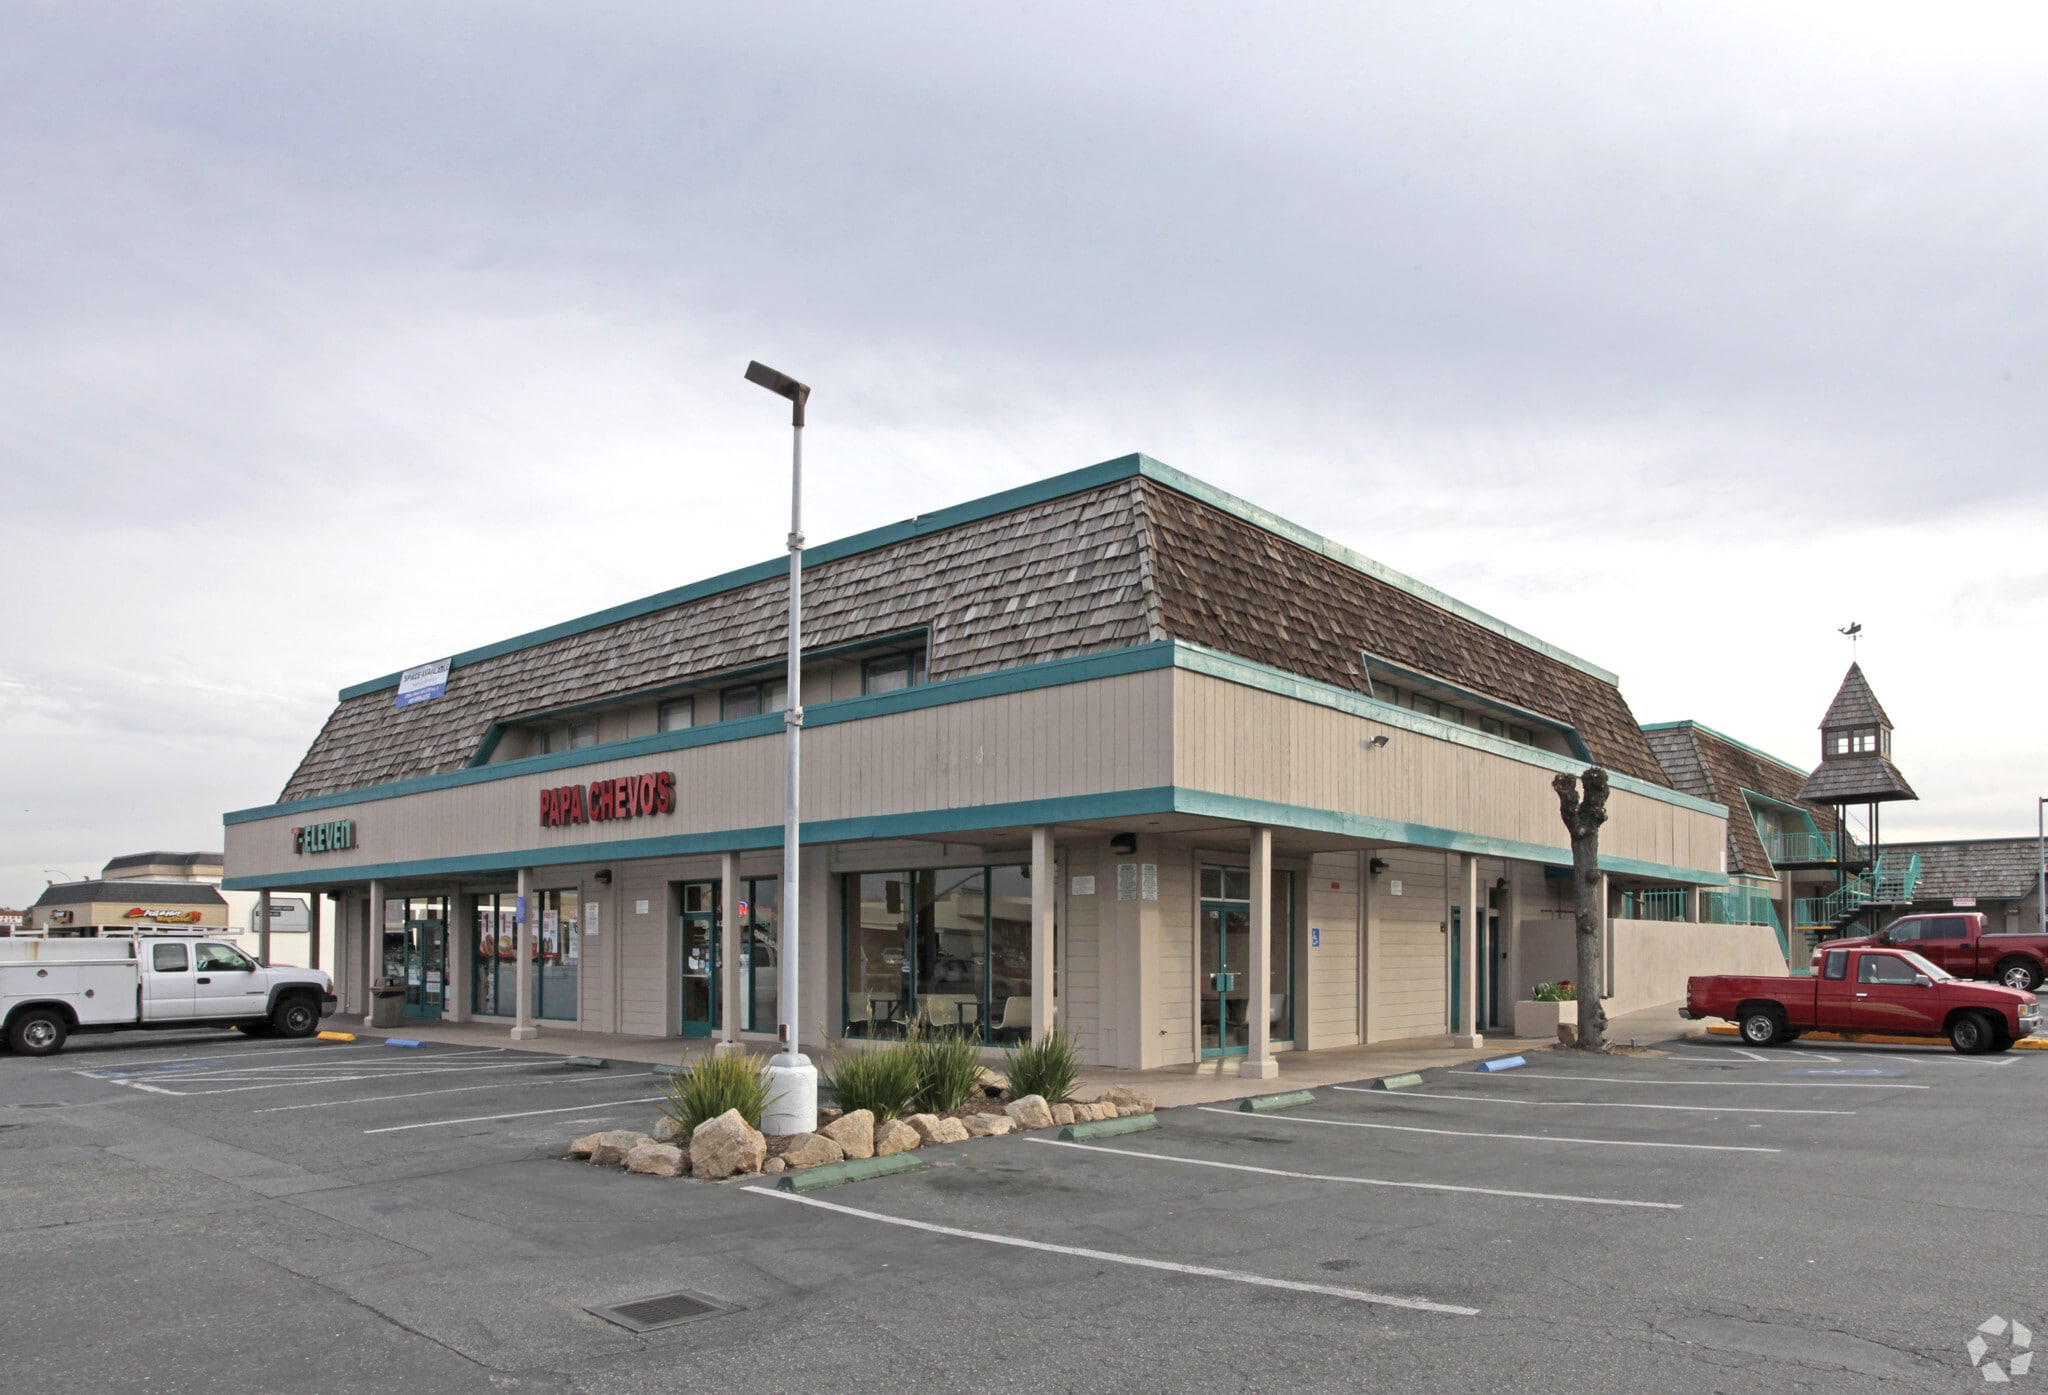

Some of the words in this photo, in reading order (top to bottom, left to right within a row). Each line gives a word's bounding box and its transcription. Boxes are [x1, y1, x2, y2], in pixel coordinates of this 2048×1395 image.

[404, 671, 421, 682] SPACE
[422, 663, 449, 677] AVAILABLE
[540, 785, 588, 827] PAPA
[588, 771, 676, 823] CHEVO'S
